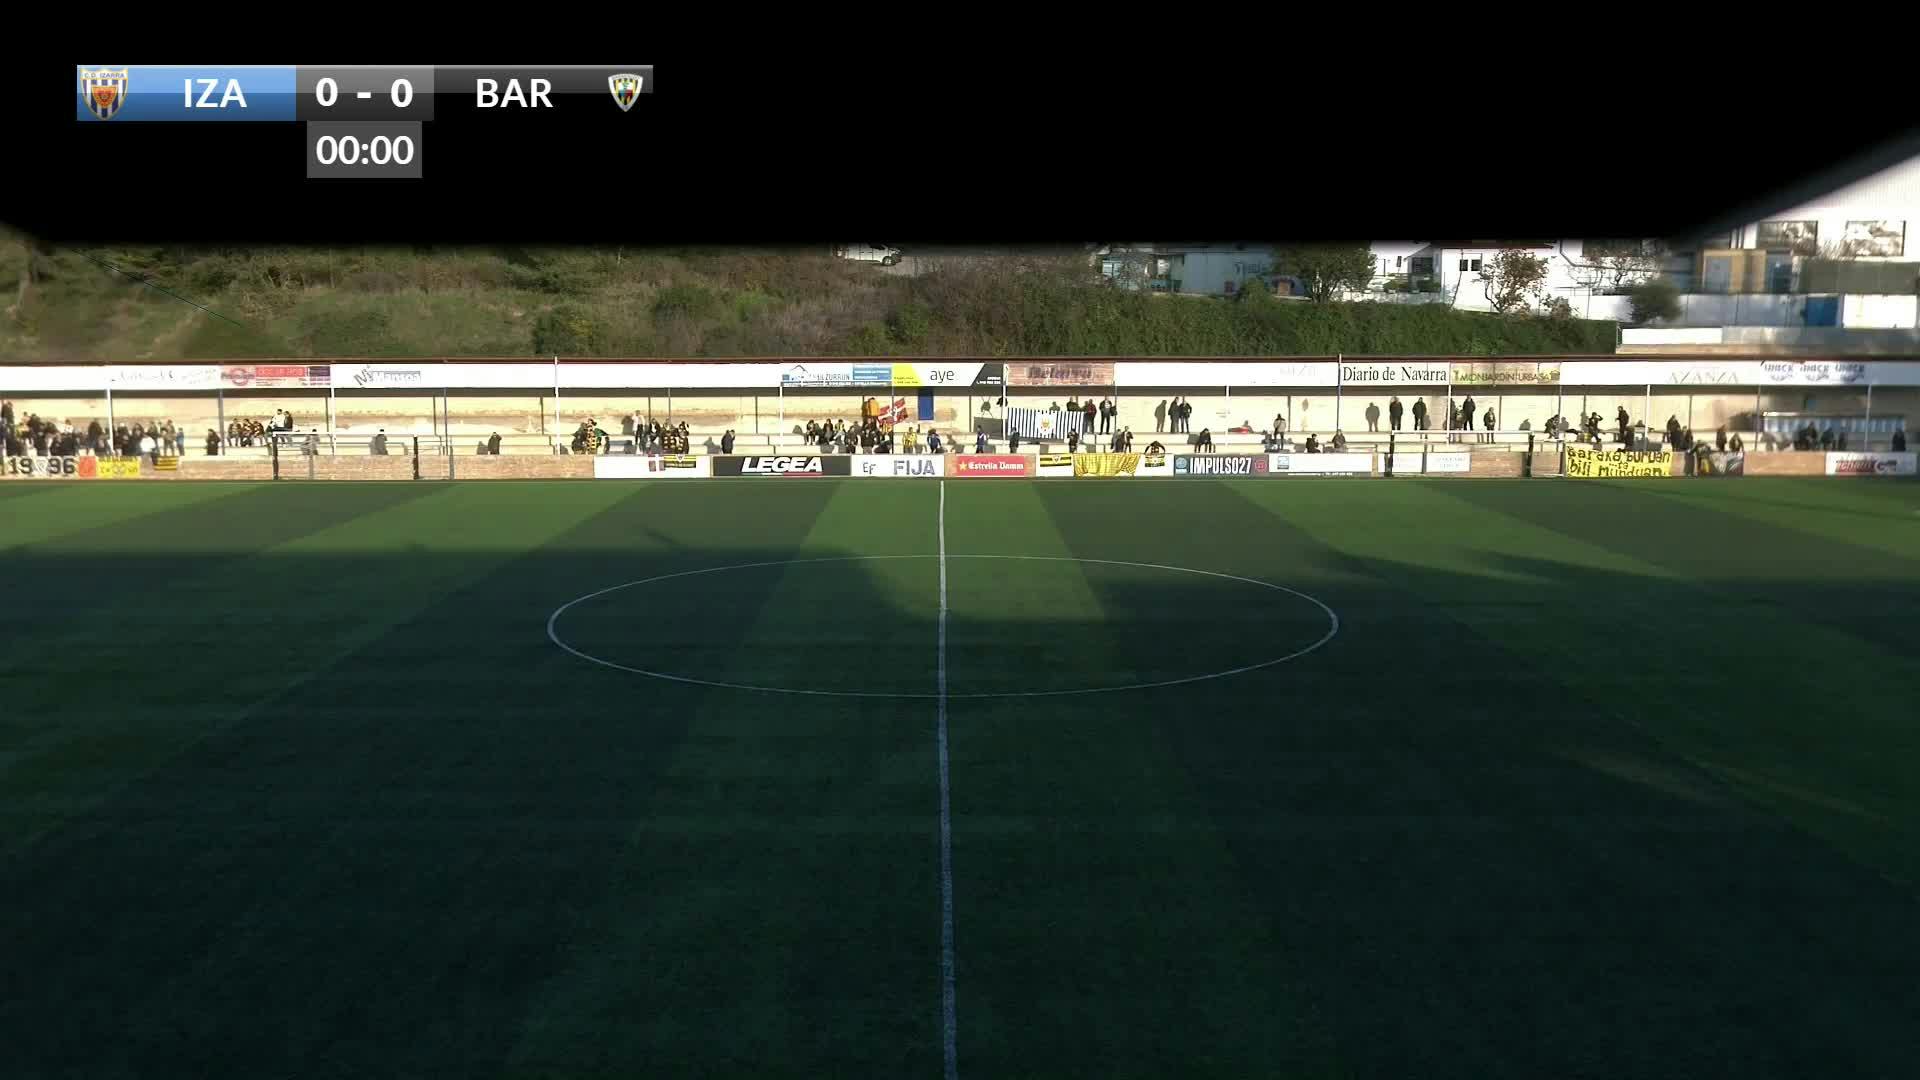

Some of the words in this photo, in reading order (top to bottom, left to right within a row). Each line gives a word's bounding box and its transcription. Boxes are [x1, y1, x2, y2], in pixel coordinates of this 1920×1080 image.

[930, 369, 955, 383] aye
[1343, 367, 1379, 382] Diario
[1382, 367, 1396, 382] de
[1401, 367, 1447, 382] Navarra
[741, 457, 823, 473] LEGEA
[893, 460, 935, 475] FIJA
[968, 461, 998, 470] Estrella
[999, 461, 1024, 470] Damm
[1189, 457, 1252, 474] IMPULSO27
